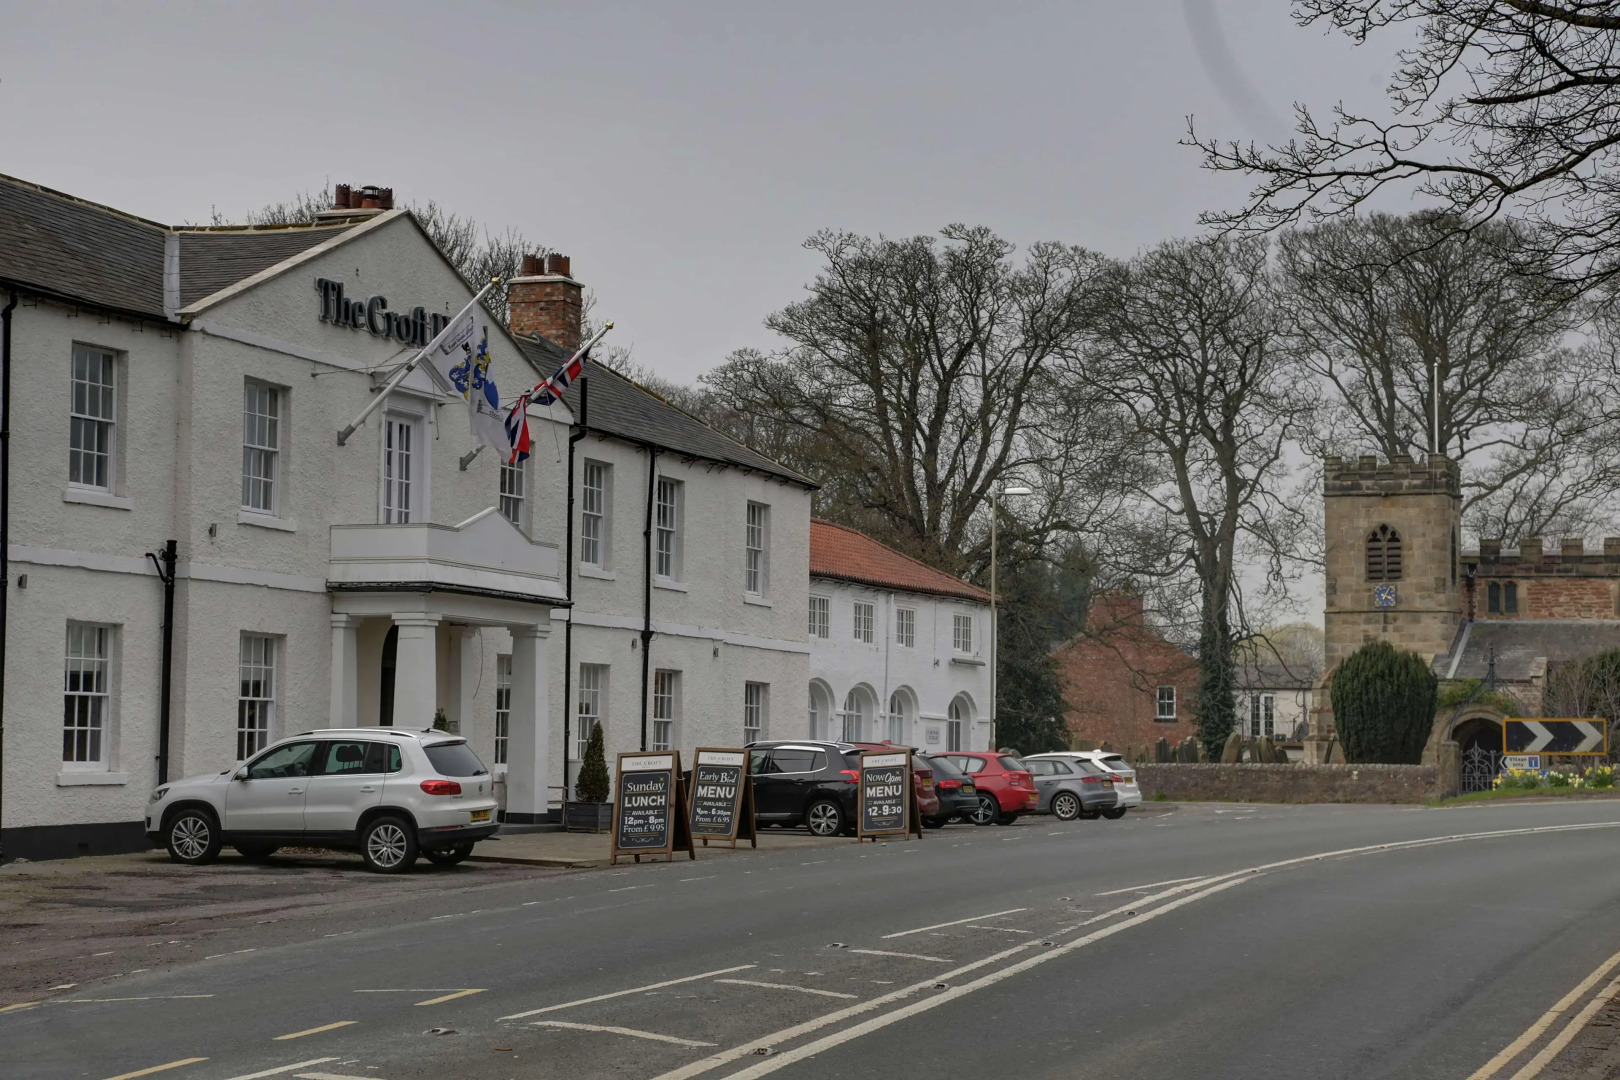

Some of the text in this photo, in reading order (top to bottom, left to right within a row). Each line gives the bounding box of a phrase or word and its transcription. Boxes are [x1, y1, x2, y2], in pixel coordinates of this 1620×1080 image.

[314, 277, 365, 330] The
[366, 294, 429, 347] Croft
[700, 771, 738, 783] Early Bird
[627, 780, 664, 793] Sunday
[696, 785, 735, 798] MENU
[866, 785, 902, 798] MENU
[624, 795, 666, 807] LUNCH
[624, 816, 644, 826] 12pm
[648, 816, 664, 824] 8pm
[623, 825, 643, 833] From
